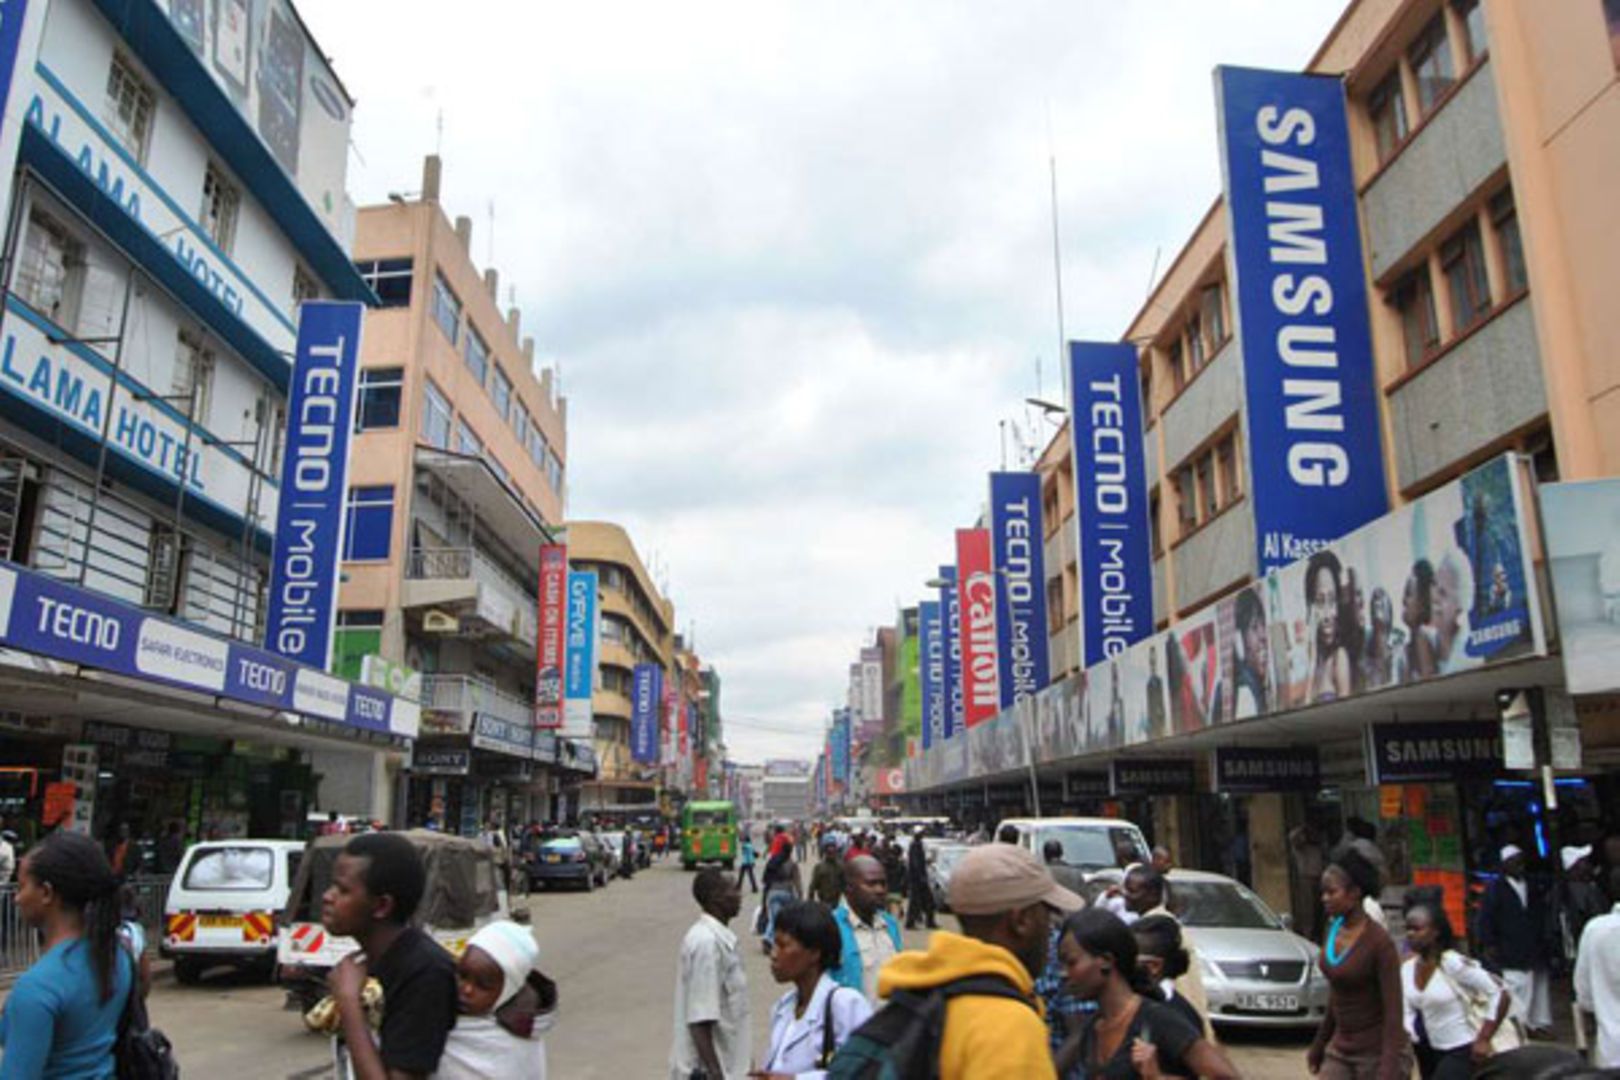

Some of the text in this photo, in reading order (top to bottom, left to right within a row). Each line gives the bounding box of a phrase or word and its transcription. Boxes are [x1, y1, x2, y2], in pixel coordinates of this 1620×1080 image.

[1256, 105, 1349, 487] SAMSUNG
[1, 334, 204, 489] LAMA HOTEL
[277, 336, 344, 654] TECNO Mobile
[1006, 497, 1032, 602] TECNO
[1090, 374, 1134, 660] TECNO Mobile
[38, 595, 120, 651] TECNO
[239, 658, 286, 695] TECNO
[966, 572, 997, 705] Canon
[355, 693, 386, 721] TECNO
[1224, 758, 1314, 777] SAMSUNG
